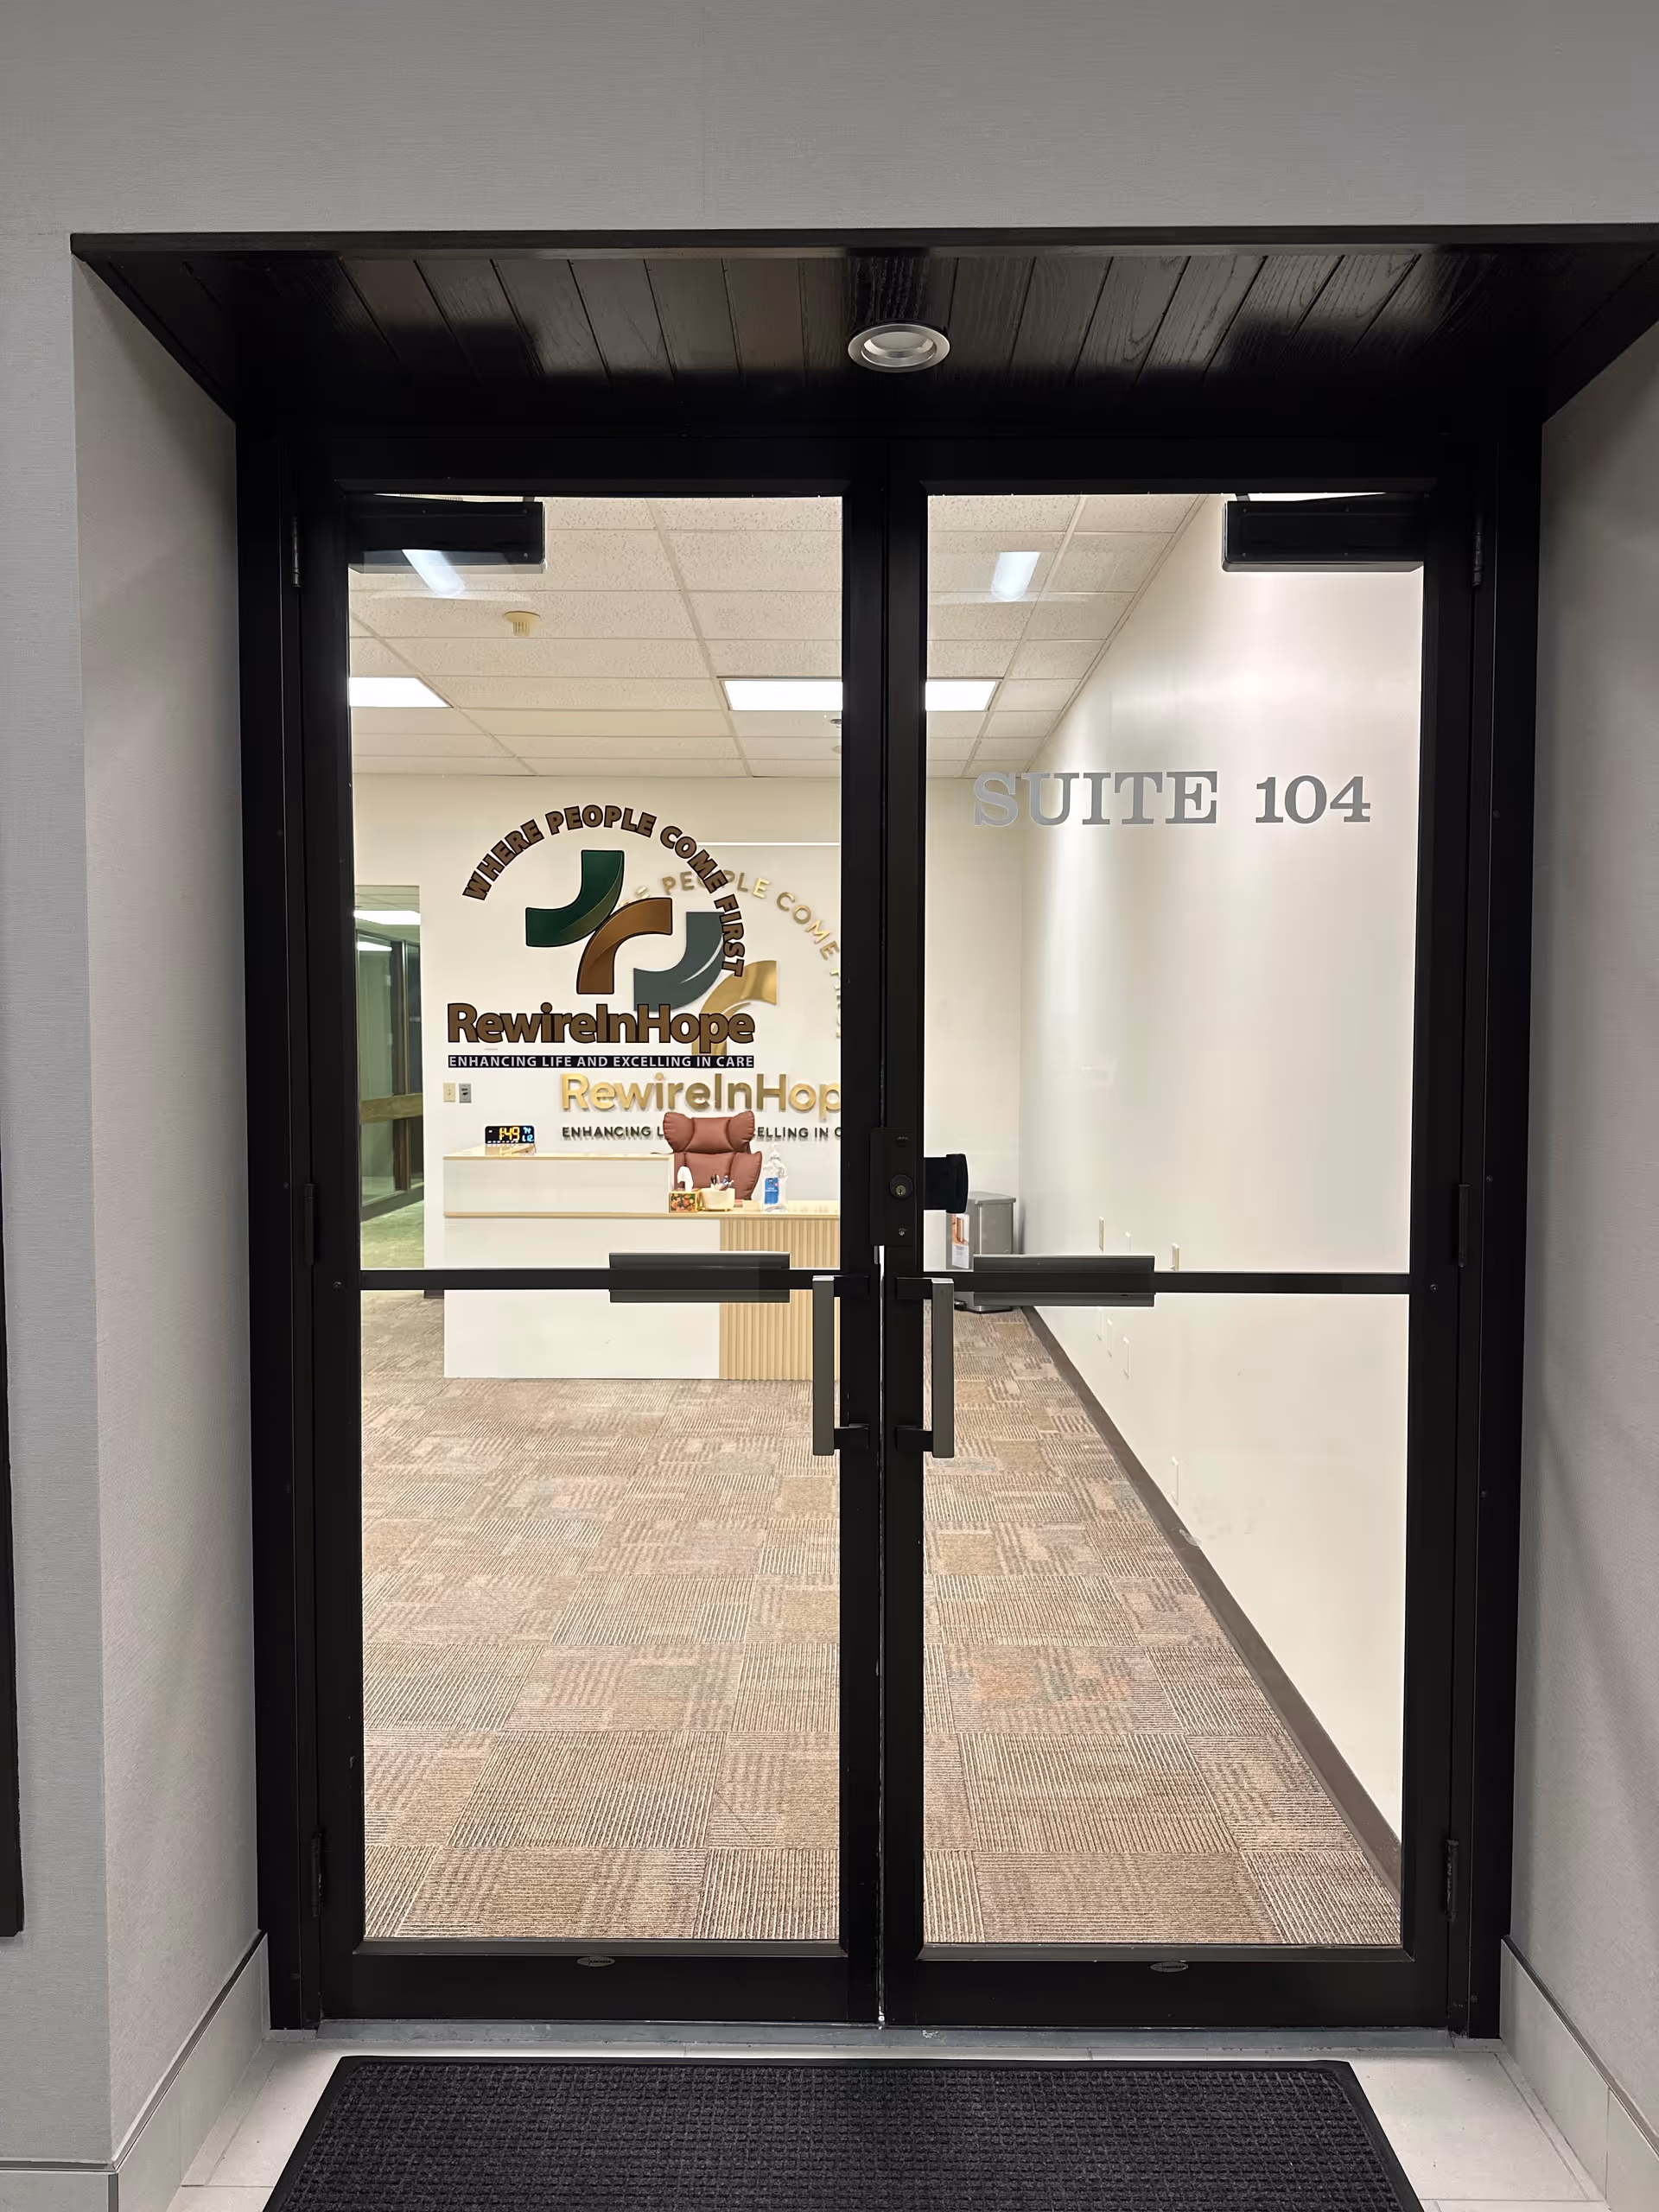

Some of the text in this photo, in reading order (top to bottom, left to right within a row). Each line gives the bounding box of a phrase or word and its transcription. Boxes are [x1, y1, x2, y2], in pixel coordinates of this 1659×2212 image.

[973, 771, 1370, 827] SUITE 104
[462, 804, 746, 977] WHERE PEOPLE COME FIRST
[777, 892, 840, 960] COME
[448, 1002, 755, 1053] RewireInHope
[448, 1056, 754, 1067] ENHANCING LIFE AND EXCELLING IN CARE
[562, 1072, 841, 1122] RewireInHop
[562, 1126, 651, 1138] ENHANCING
[815, 1127, 829, 1138] IN
